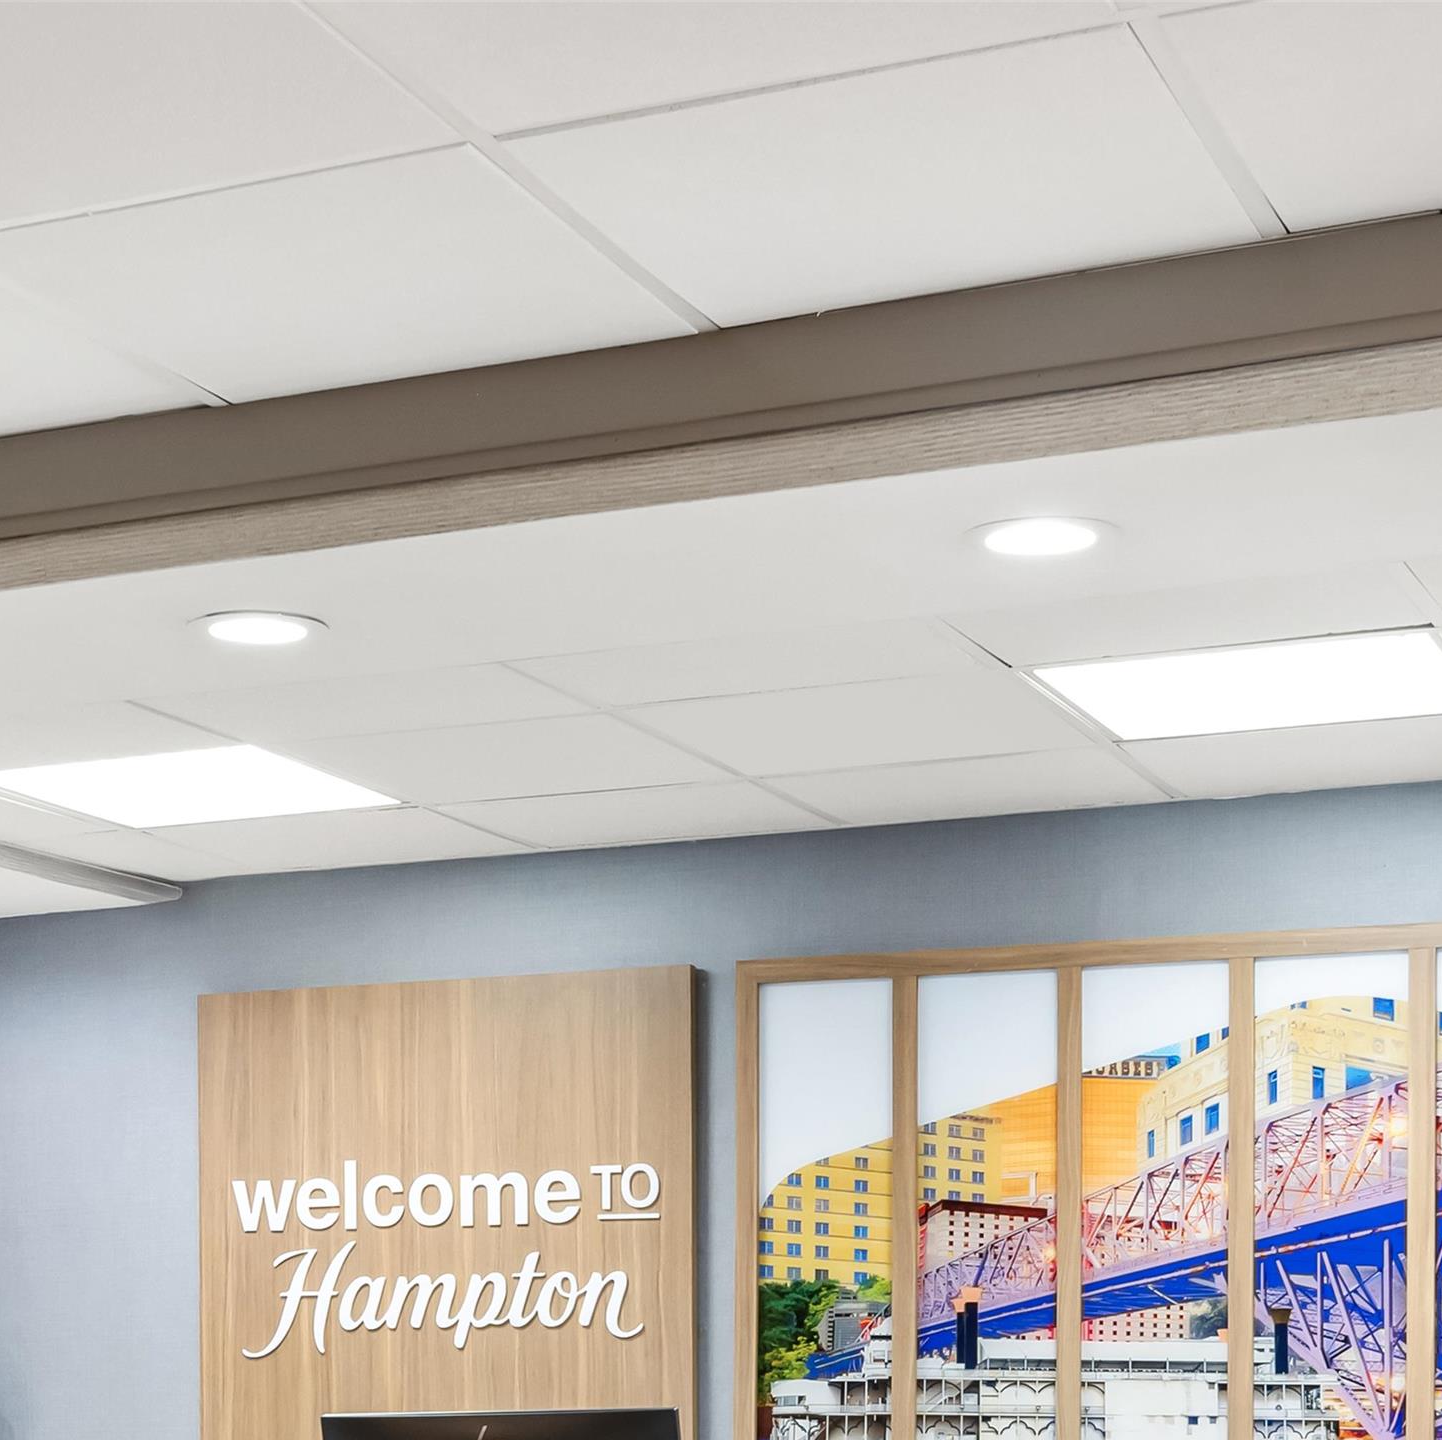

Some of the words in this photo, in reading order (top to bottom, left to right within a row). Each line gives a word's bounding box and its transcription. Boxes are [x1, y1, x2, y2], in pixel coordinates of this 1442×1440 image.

[232, 1160, 582, 1232] welcome
[590, 1163, 661, 1216] TO
[242, 1241, 645, 1358] Hampton
